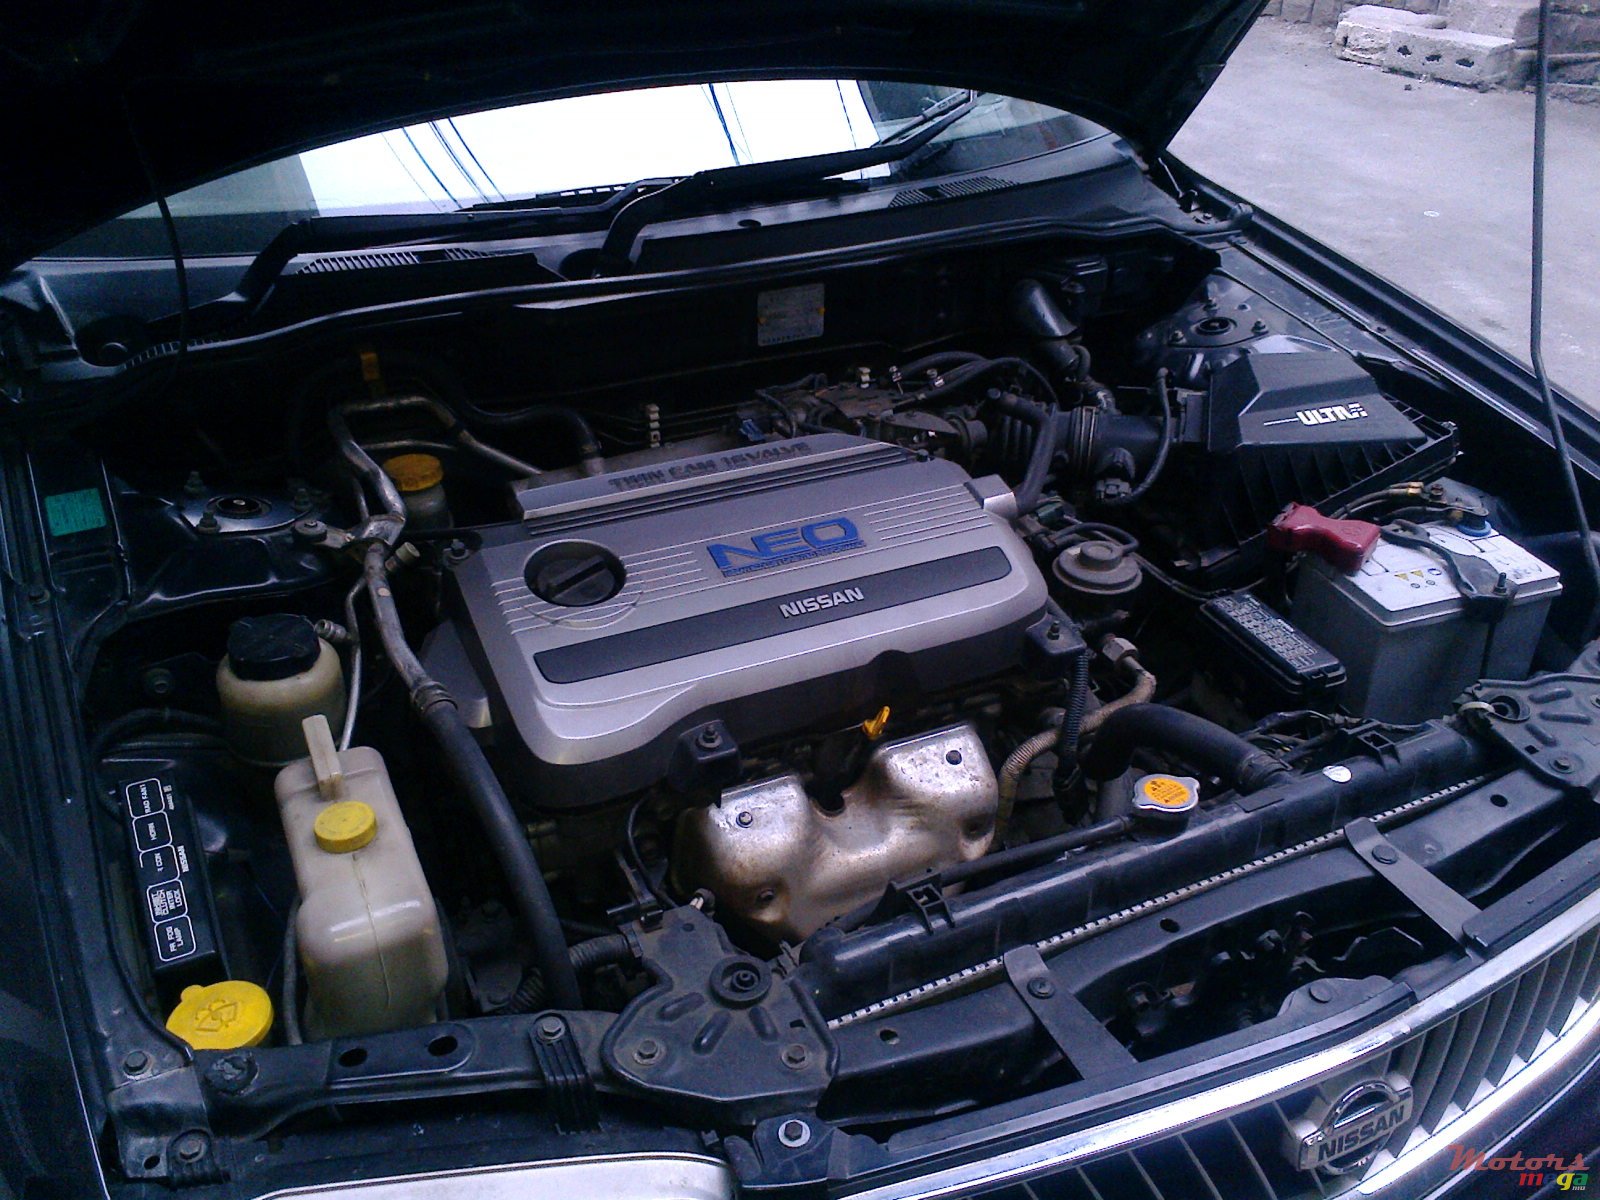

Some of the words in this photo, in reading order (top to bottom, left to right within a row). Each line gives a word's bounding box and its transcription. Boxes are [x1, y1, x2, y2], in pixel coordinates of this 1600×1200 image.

[1296, 402, 1368, 426] ULTRA
[608, 469, 664, 490] TWIN
[668, 459, 717, 479] CAM
[706, 516, 860, 570] NEO
[778, 587, 865, 618] NISSAN
[147, 822, 157, 841] HORN
[177, 845, 190, 873] NISSAN
[173, 889, 183, 907] LOCK
[165, 926, 175, 941] FOG
[173, 927, 184, 947] LAMP
[1319, 1105, 1404, 1162] NISSAN
